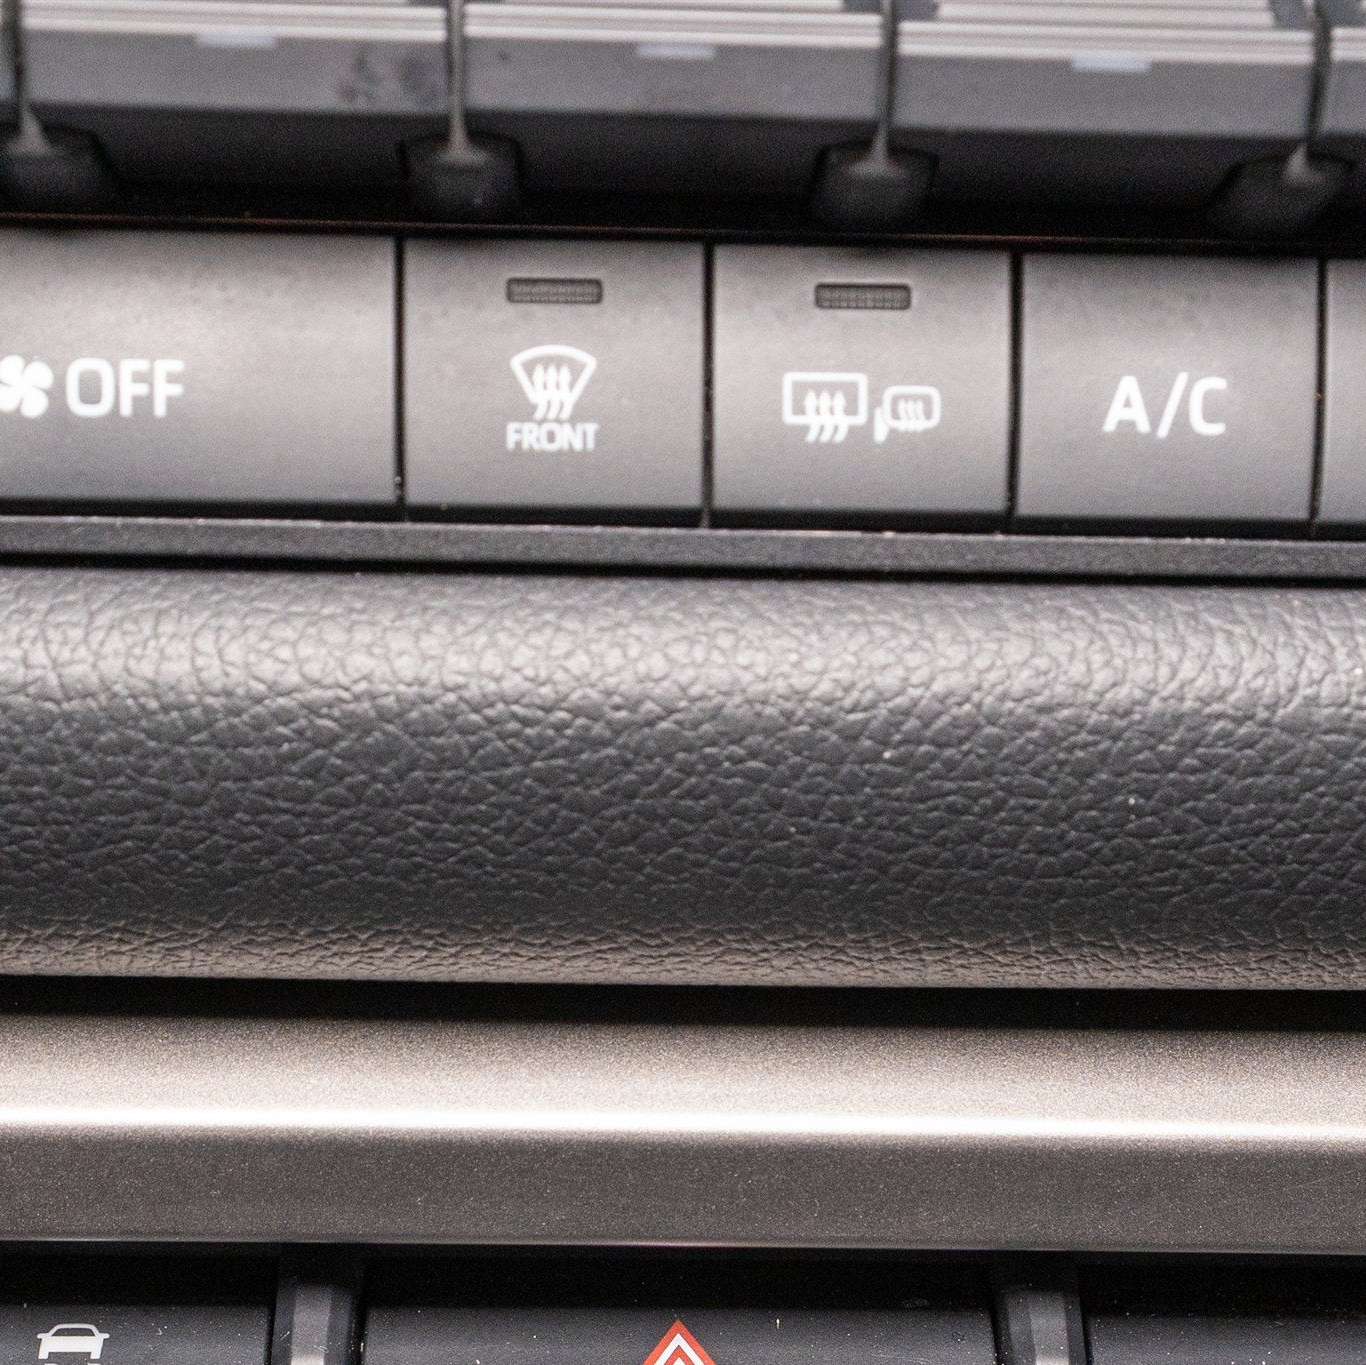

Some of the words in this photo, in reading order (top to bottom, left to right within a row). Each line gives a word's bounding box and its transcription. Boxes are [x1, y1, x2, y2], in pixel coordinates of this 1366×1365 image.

[65, 356, 186, 419] OFF
[1103, 371, 1228, 438] A/C
[506, 422, 599, 452] FRONT
